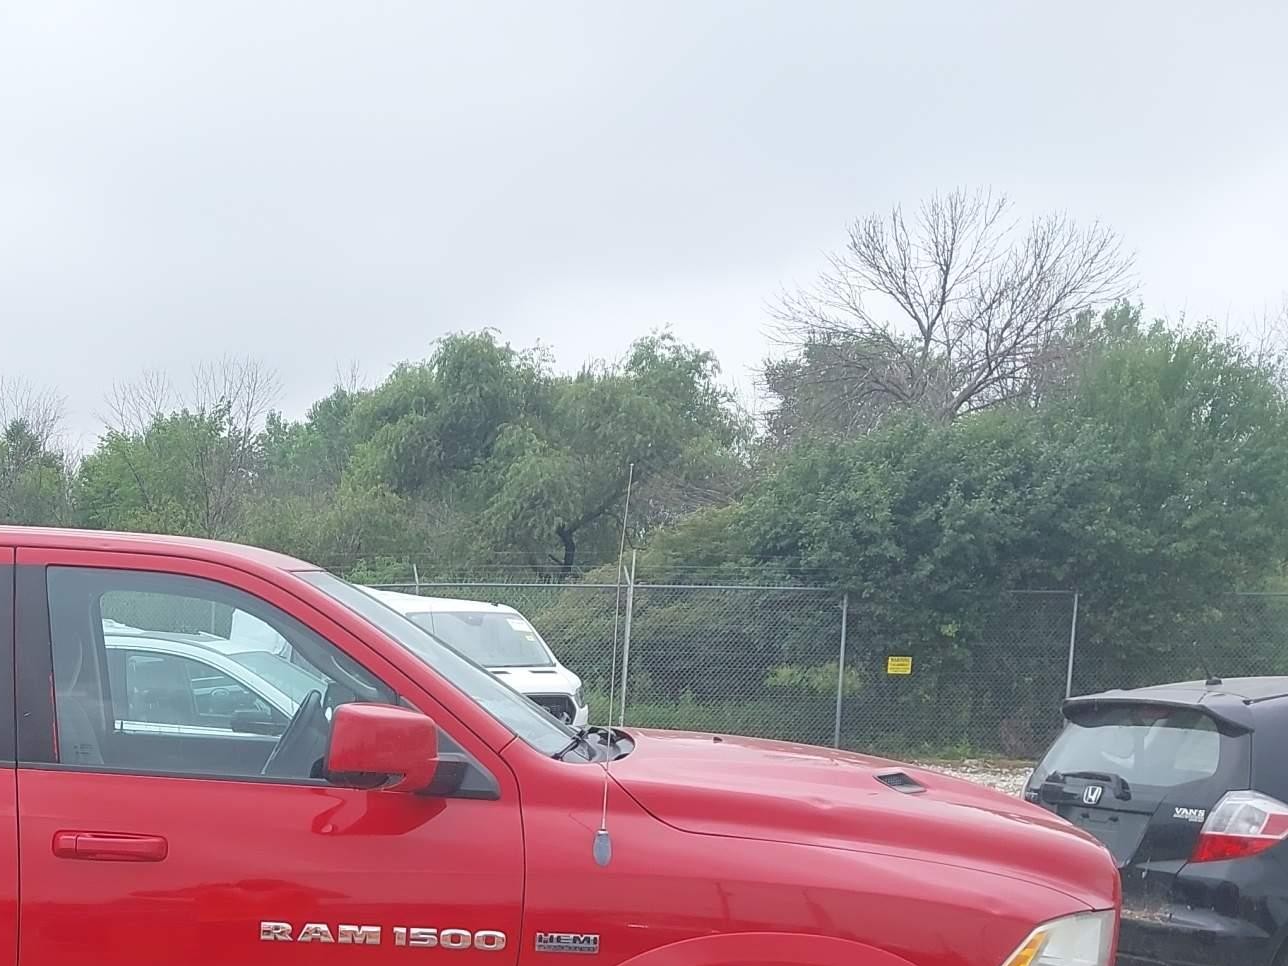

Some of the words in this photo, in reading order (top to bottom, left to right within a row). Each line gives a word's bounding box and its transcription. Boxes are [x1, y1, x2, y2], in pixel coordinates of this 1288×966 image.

[260, 921, 382, 946] RAM
[392, 926, 507, 951] 1500
[537, 933, 599, 945] HEMI
